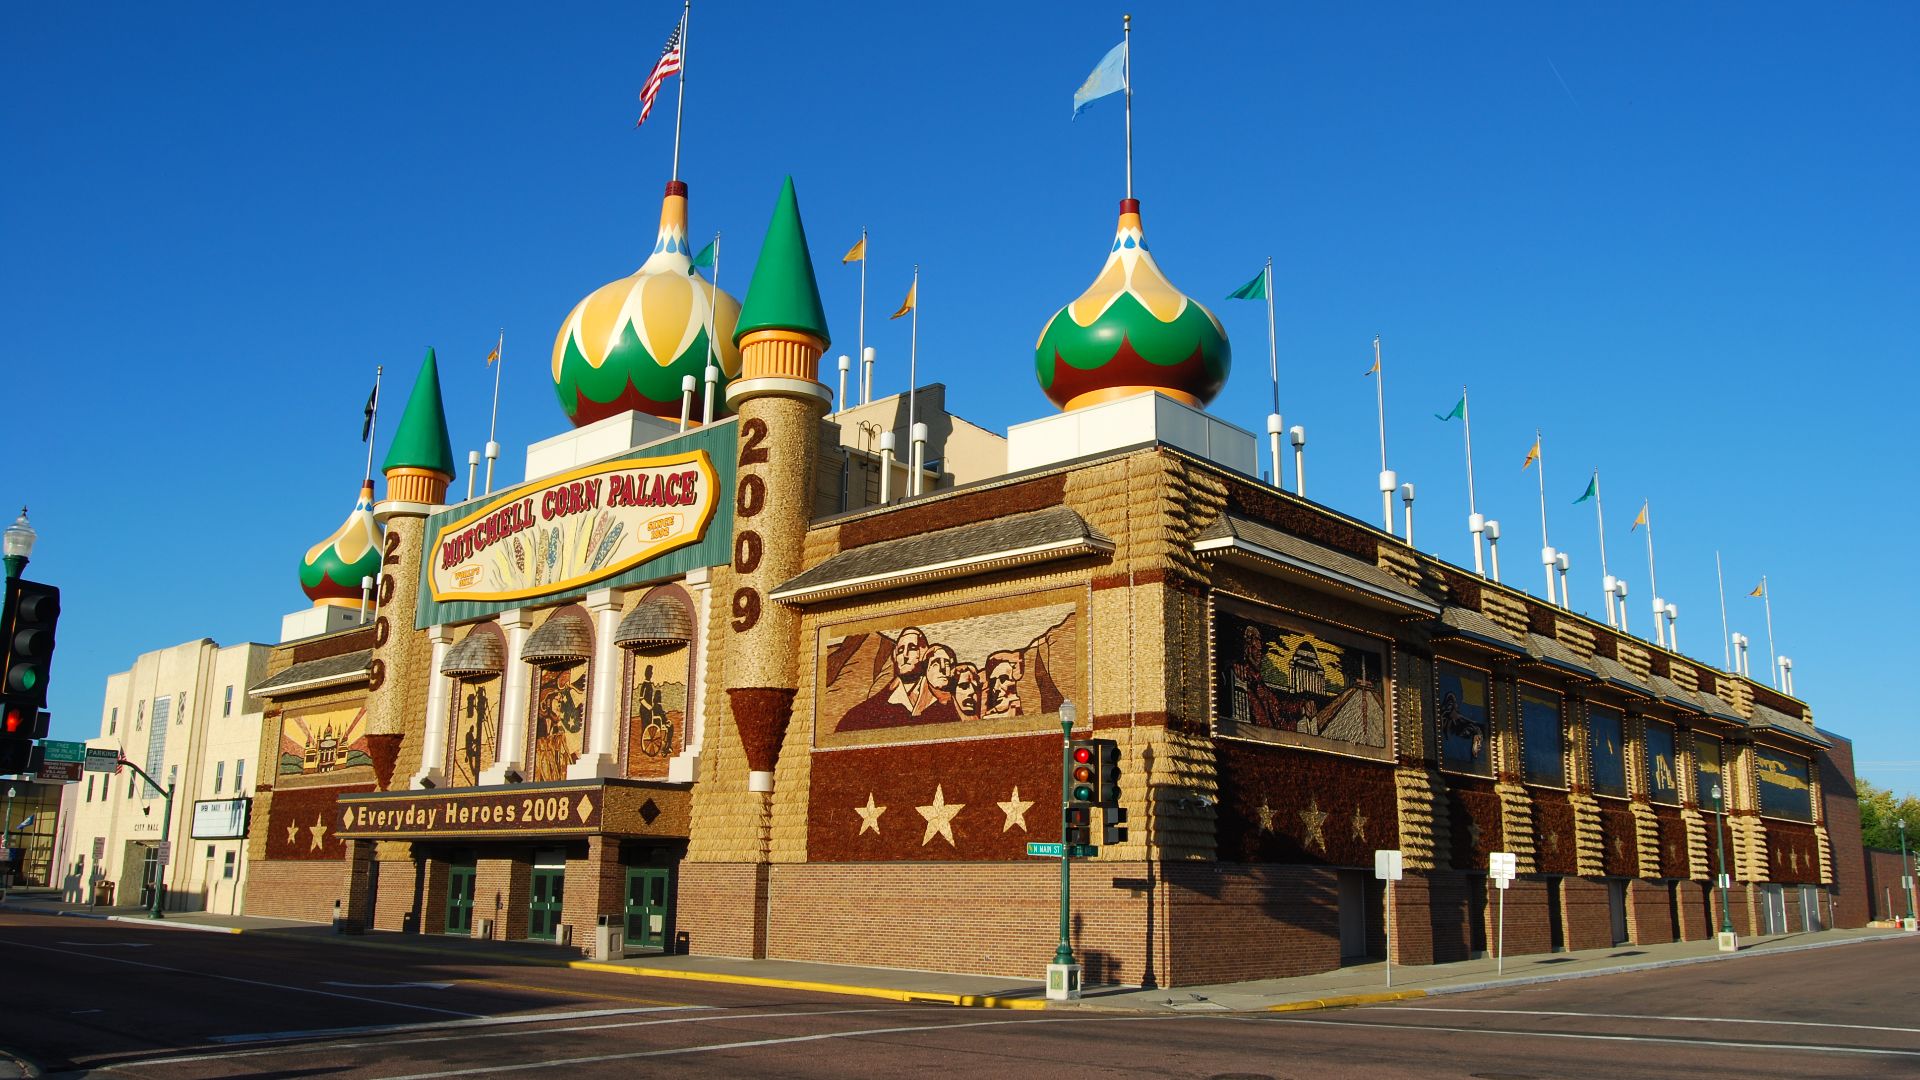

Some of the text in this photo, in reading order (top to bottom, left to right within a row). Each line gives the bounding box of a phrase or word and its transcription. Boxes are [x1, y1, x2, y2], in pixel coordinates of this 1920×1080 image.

[441, 470, 698, 570] MITCHELL CORN PALACE
[647, 516, 675, 532] SINCE
[731, 417, 769, 634] 2009
[368, 531, 401, 692] 2009
[88, 749, 117, 758] PARKING
[357, 796, 569, 831] Everyday Heroes 2008
[134, 823, 159, 832] CITY HALL
[1033, 845, 1060, 854] N MAIN ST
